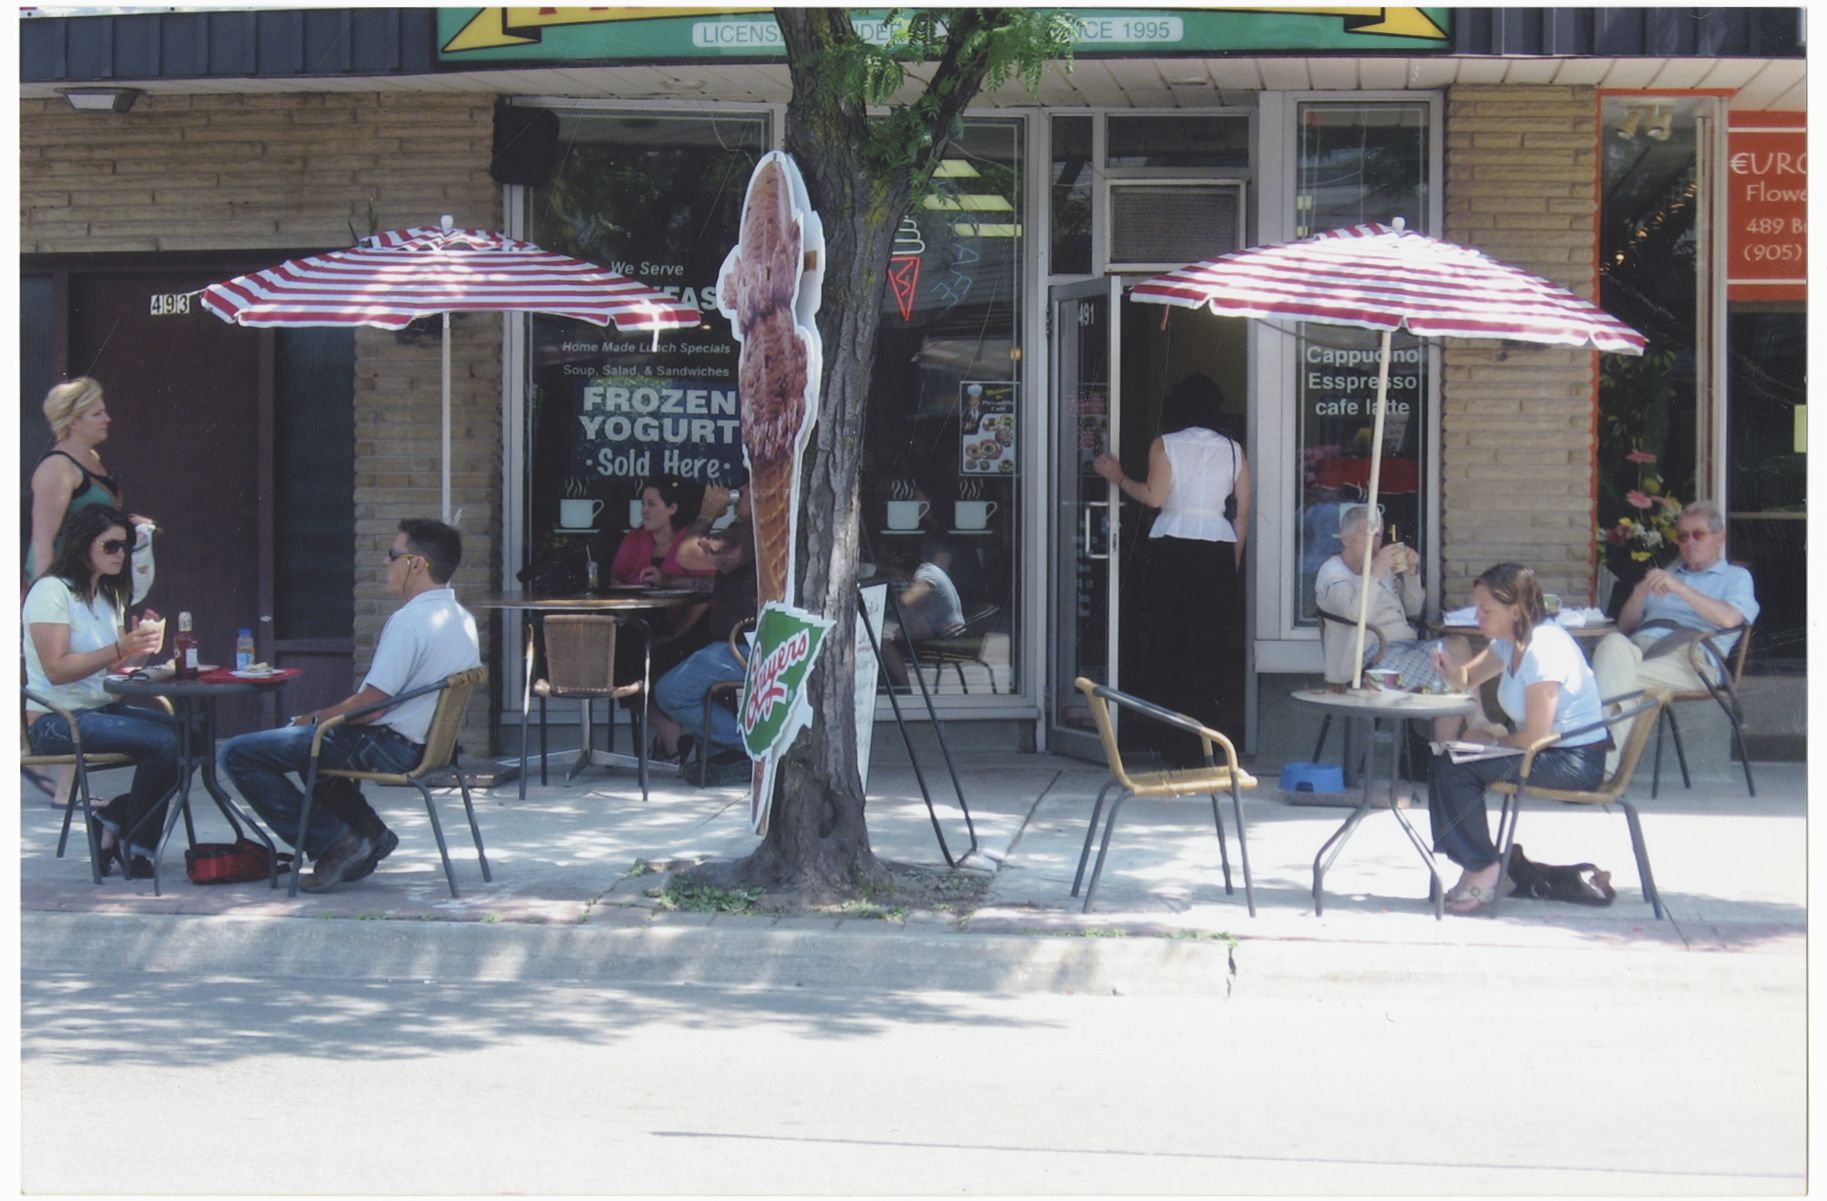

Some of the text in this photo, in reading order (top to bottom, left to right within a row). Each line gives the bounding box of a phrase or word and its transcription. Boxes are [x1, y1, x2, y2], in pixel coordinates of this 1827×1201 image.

[703, 24, 783, 43] LICENS
[1122, 21, 1170, 39] 1995
[1745, 218, 1785, 235] 489
[1743, 244, 1802, 262] (905)
[611, 260, 684, 276] We Serve
[151, 294, 189, 315] 493
[1078, 302, 1095, 327] 491
[562, 341, 599, 353] Home
[602, 341, 635, 353] Made
[680, 342, 731, 356] Specials
[1306, 346, 1419, 367] Cappucno
[563, 365, 599, 377] Soup,
[643, 366, 653, 376] &
[656, 365, 730, 377] Sandwiches
[583, 386, 736, 415] FROZEN
[1315, 398, 1359, 416] cafe
[579, 415, 740, 444] YOGURT
[597, 447, 720, 478] Sold Here
